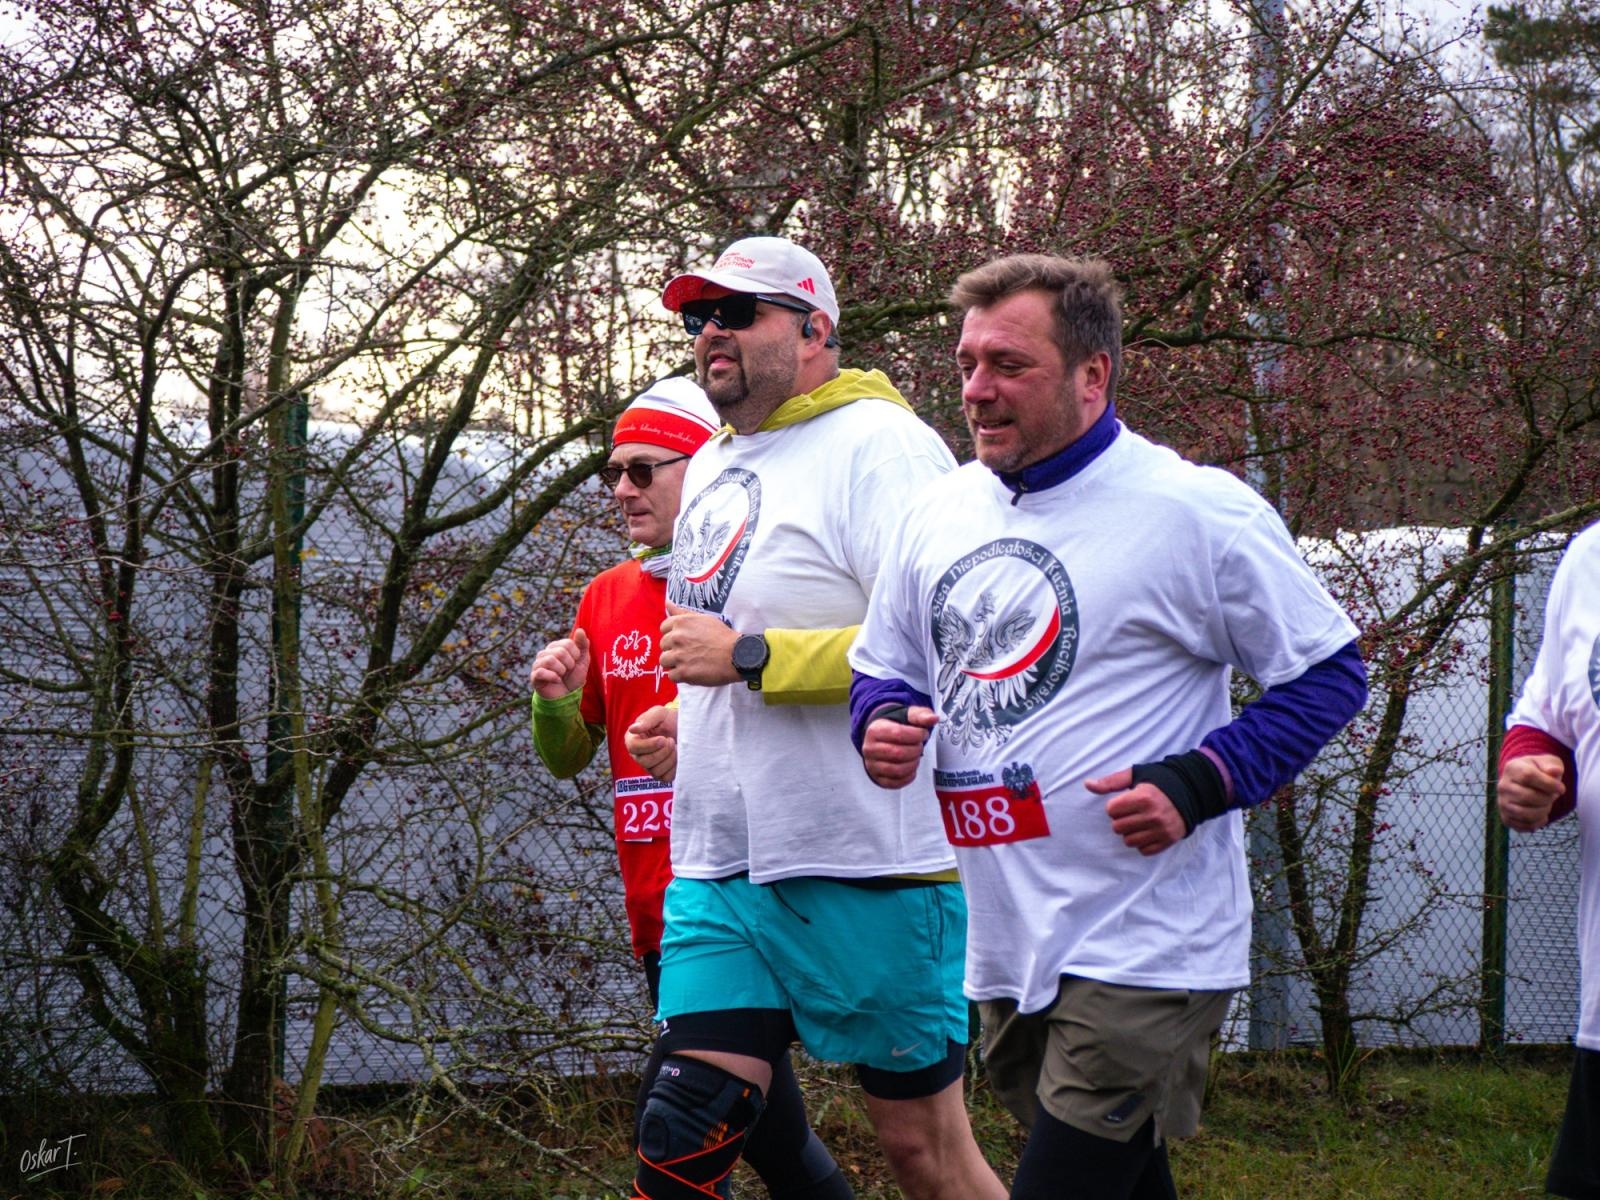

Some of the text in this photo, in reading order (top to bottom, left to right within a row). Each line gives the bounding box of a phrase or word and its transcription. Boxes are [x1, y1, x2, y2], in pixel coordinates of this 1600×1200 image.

[950, 540, 1048, 581] Niepodległości
[1044, 557, 1074, 616] Kuźnia
[1023, 623, 1078, 711] Raciborska
[947, 795, 1016, 840] 188
